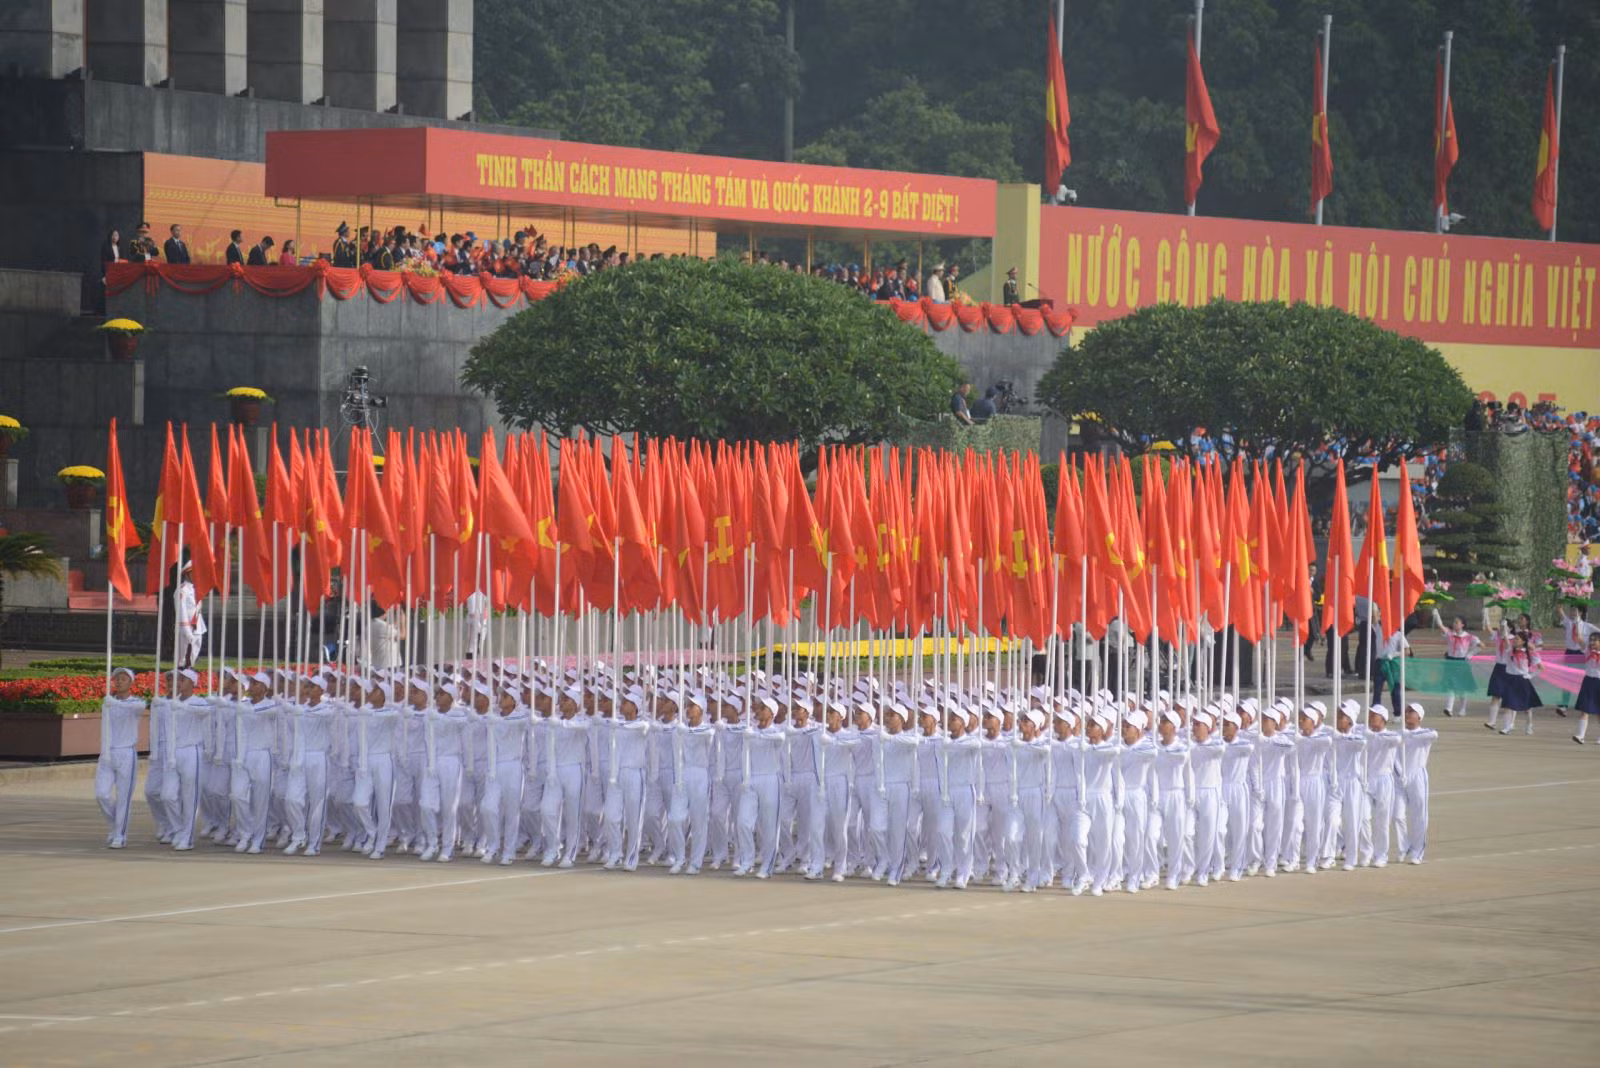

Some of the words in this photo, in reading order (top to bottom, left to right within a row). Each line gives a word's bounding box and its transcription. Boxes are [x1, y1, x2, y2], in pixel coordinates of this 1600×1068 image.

[477, 153, 517, 189] TINH
[569, 157, 610, 196] CÁCH
[614, 166, 657, 205] MẠNG
[661, 166, 712, 206] THÁNG
[715, 170, 747, 208] TÁM
[751, 173, 769, 209] VÀ
[773, 174, 809, 212] QUỐC
[813, 180, 860, 216] KHÁNH
[863, 188, 888, 219] 2-9
[892, 182, 919, 220] BẤT
[922, 188, 959, 228] DIỆT!
[1067, 224, 1141, 309] NƯỚC
[1242, 235, 1291, 308] HÒA
[1306, 239, 1334, 308] XÃ
[1403, 241, 1451, 324] CHỦ
[1463, 253, 1534, 328] NGHĨA
[1547, 255, 1597, 343] VIỆT
